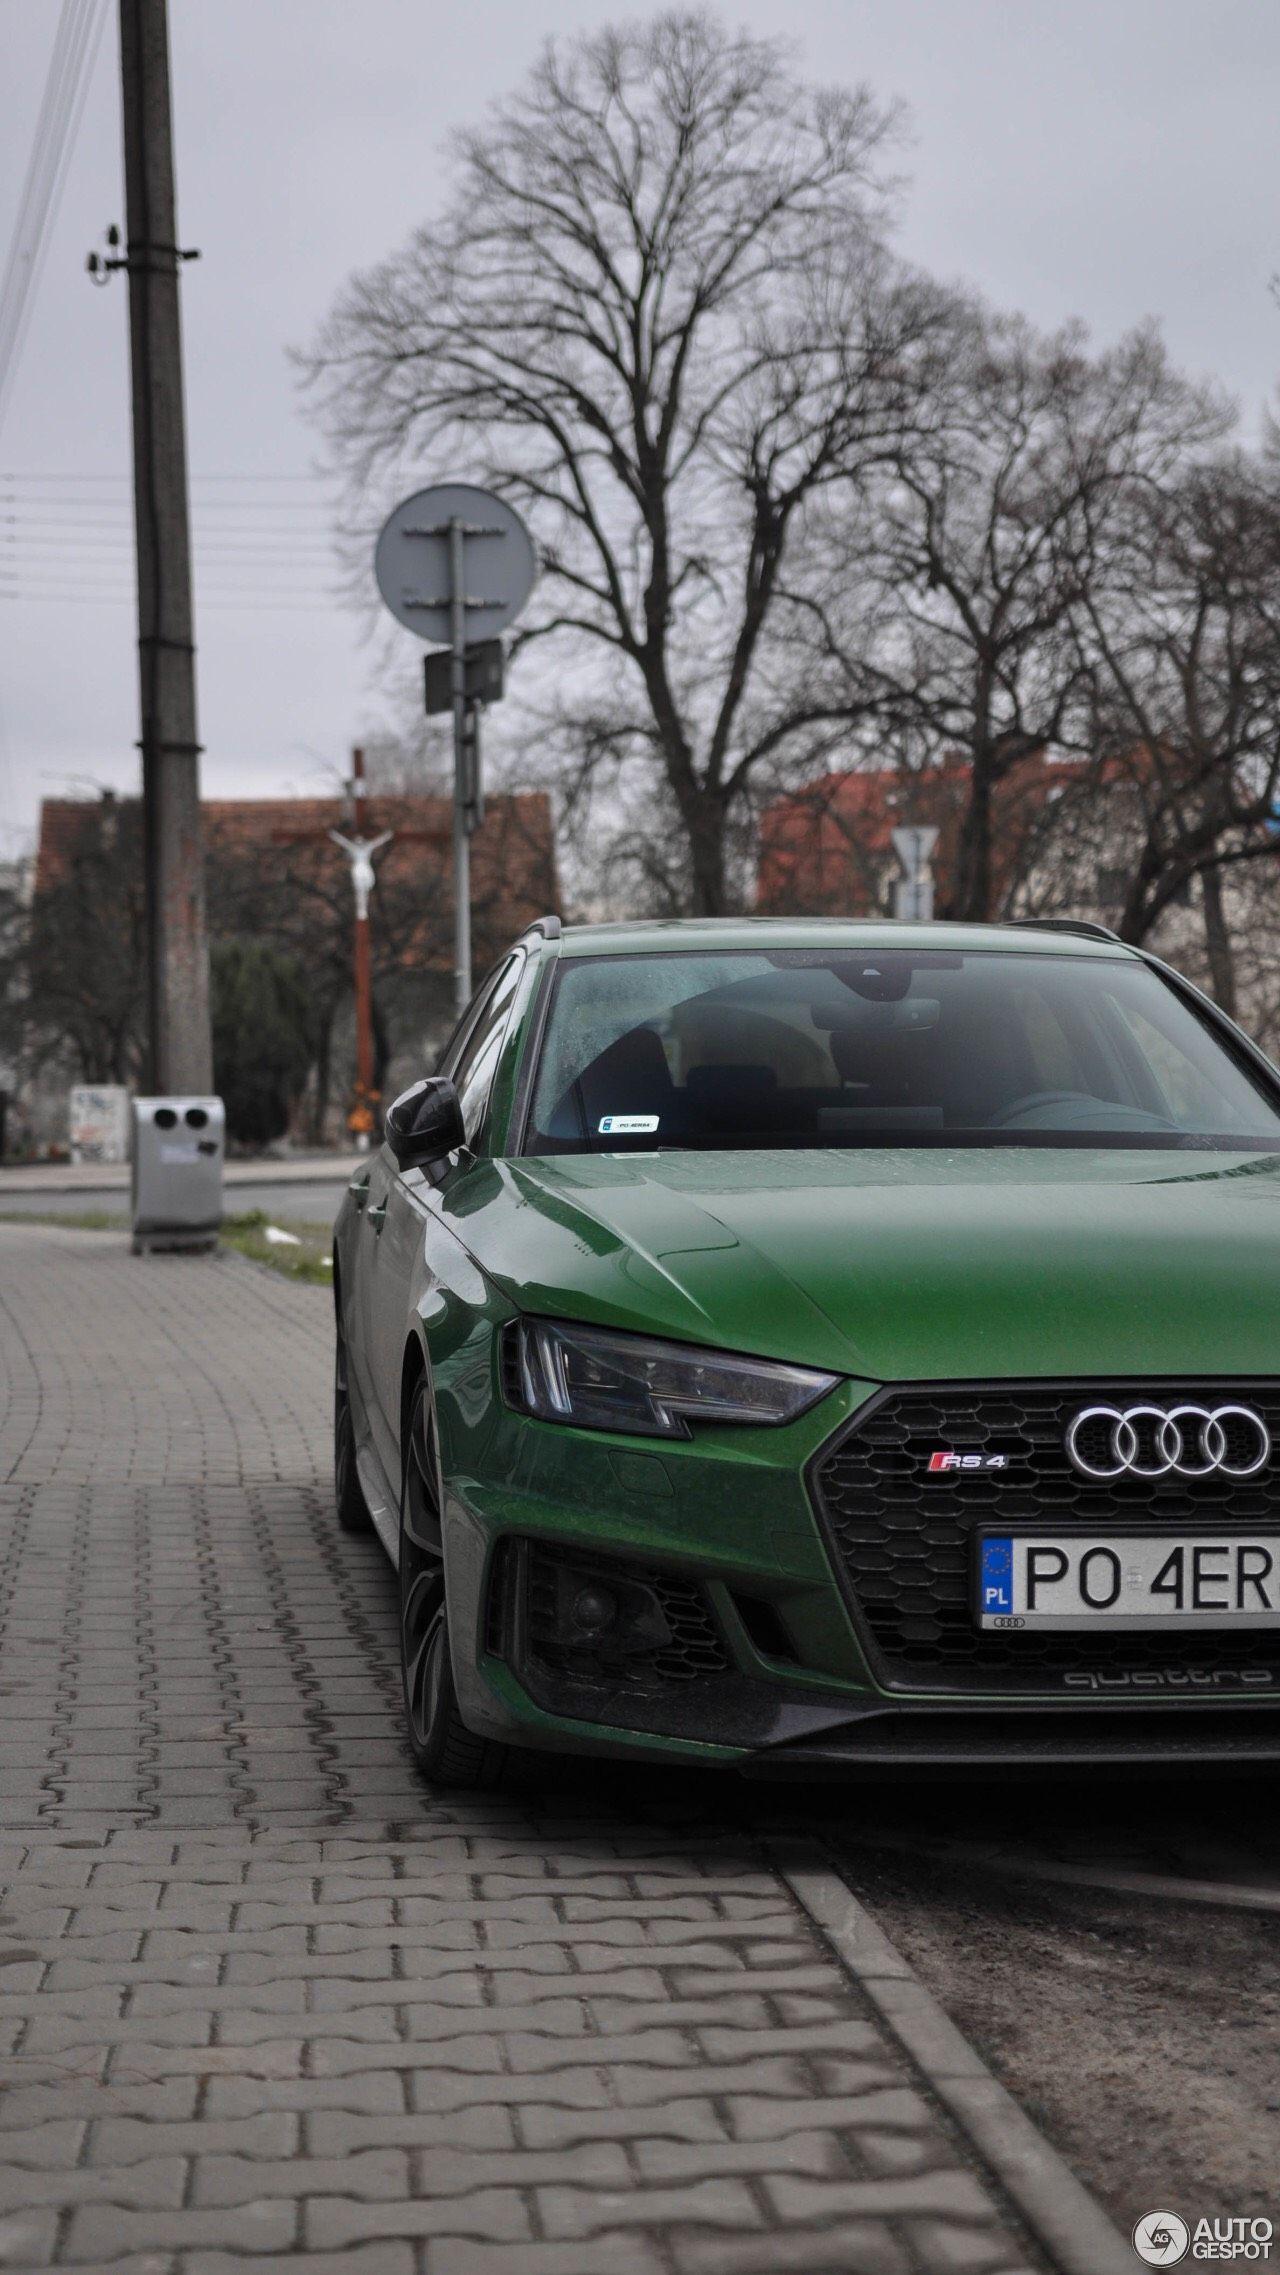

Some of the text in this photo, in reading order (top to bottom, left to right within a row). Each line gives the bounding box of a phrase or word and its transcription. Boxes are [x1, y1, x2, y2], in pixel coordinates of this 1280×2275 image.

[1026, 1546, 1122, 1610] PO
[986, 1588, 1008, 1604] PL
[1063, 1669, 1273, 1689] quattro
